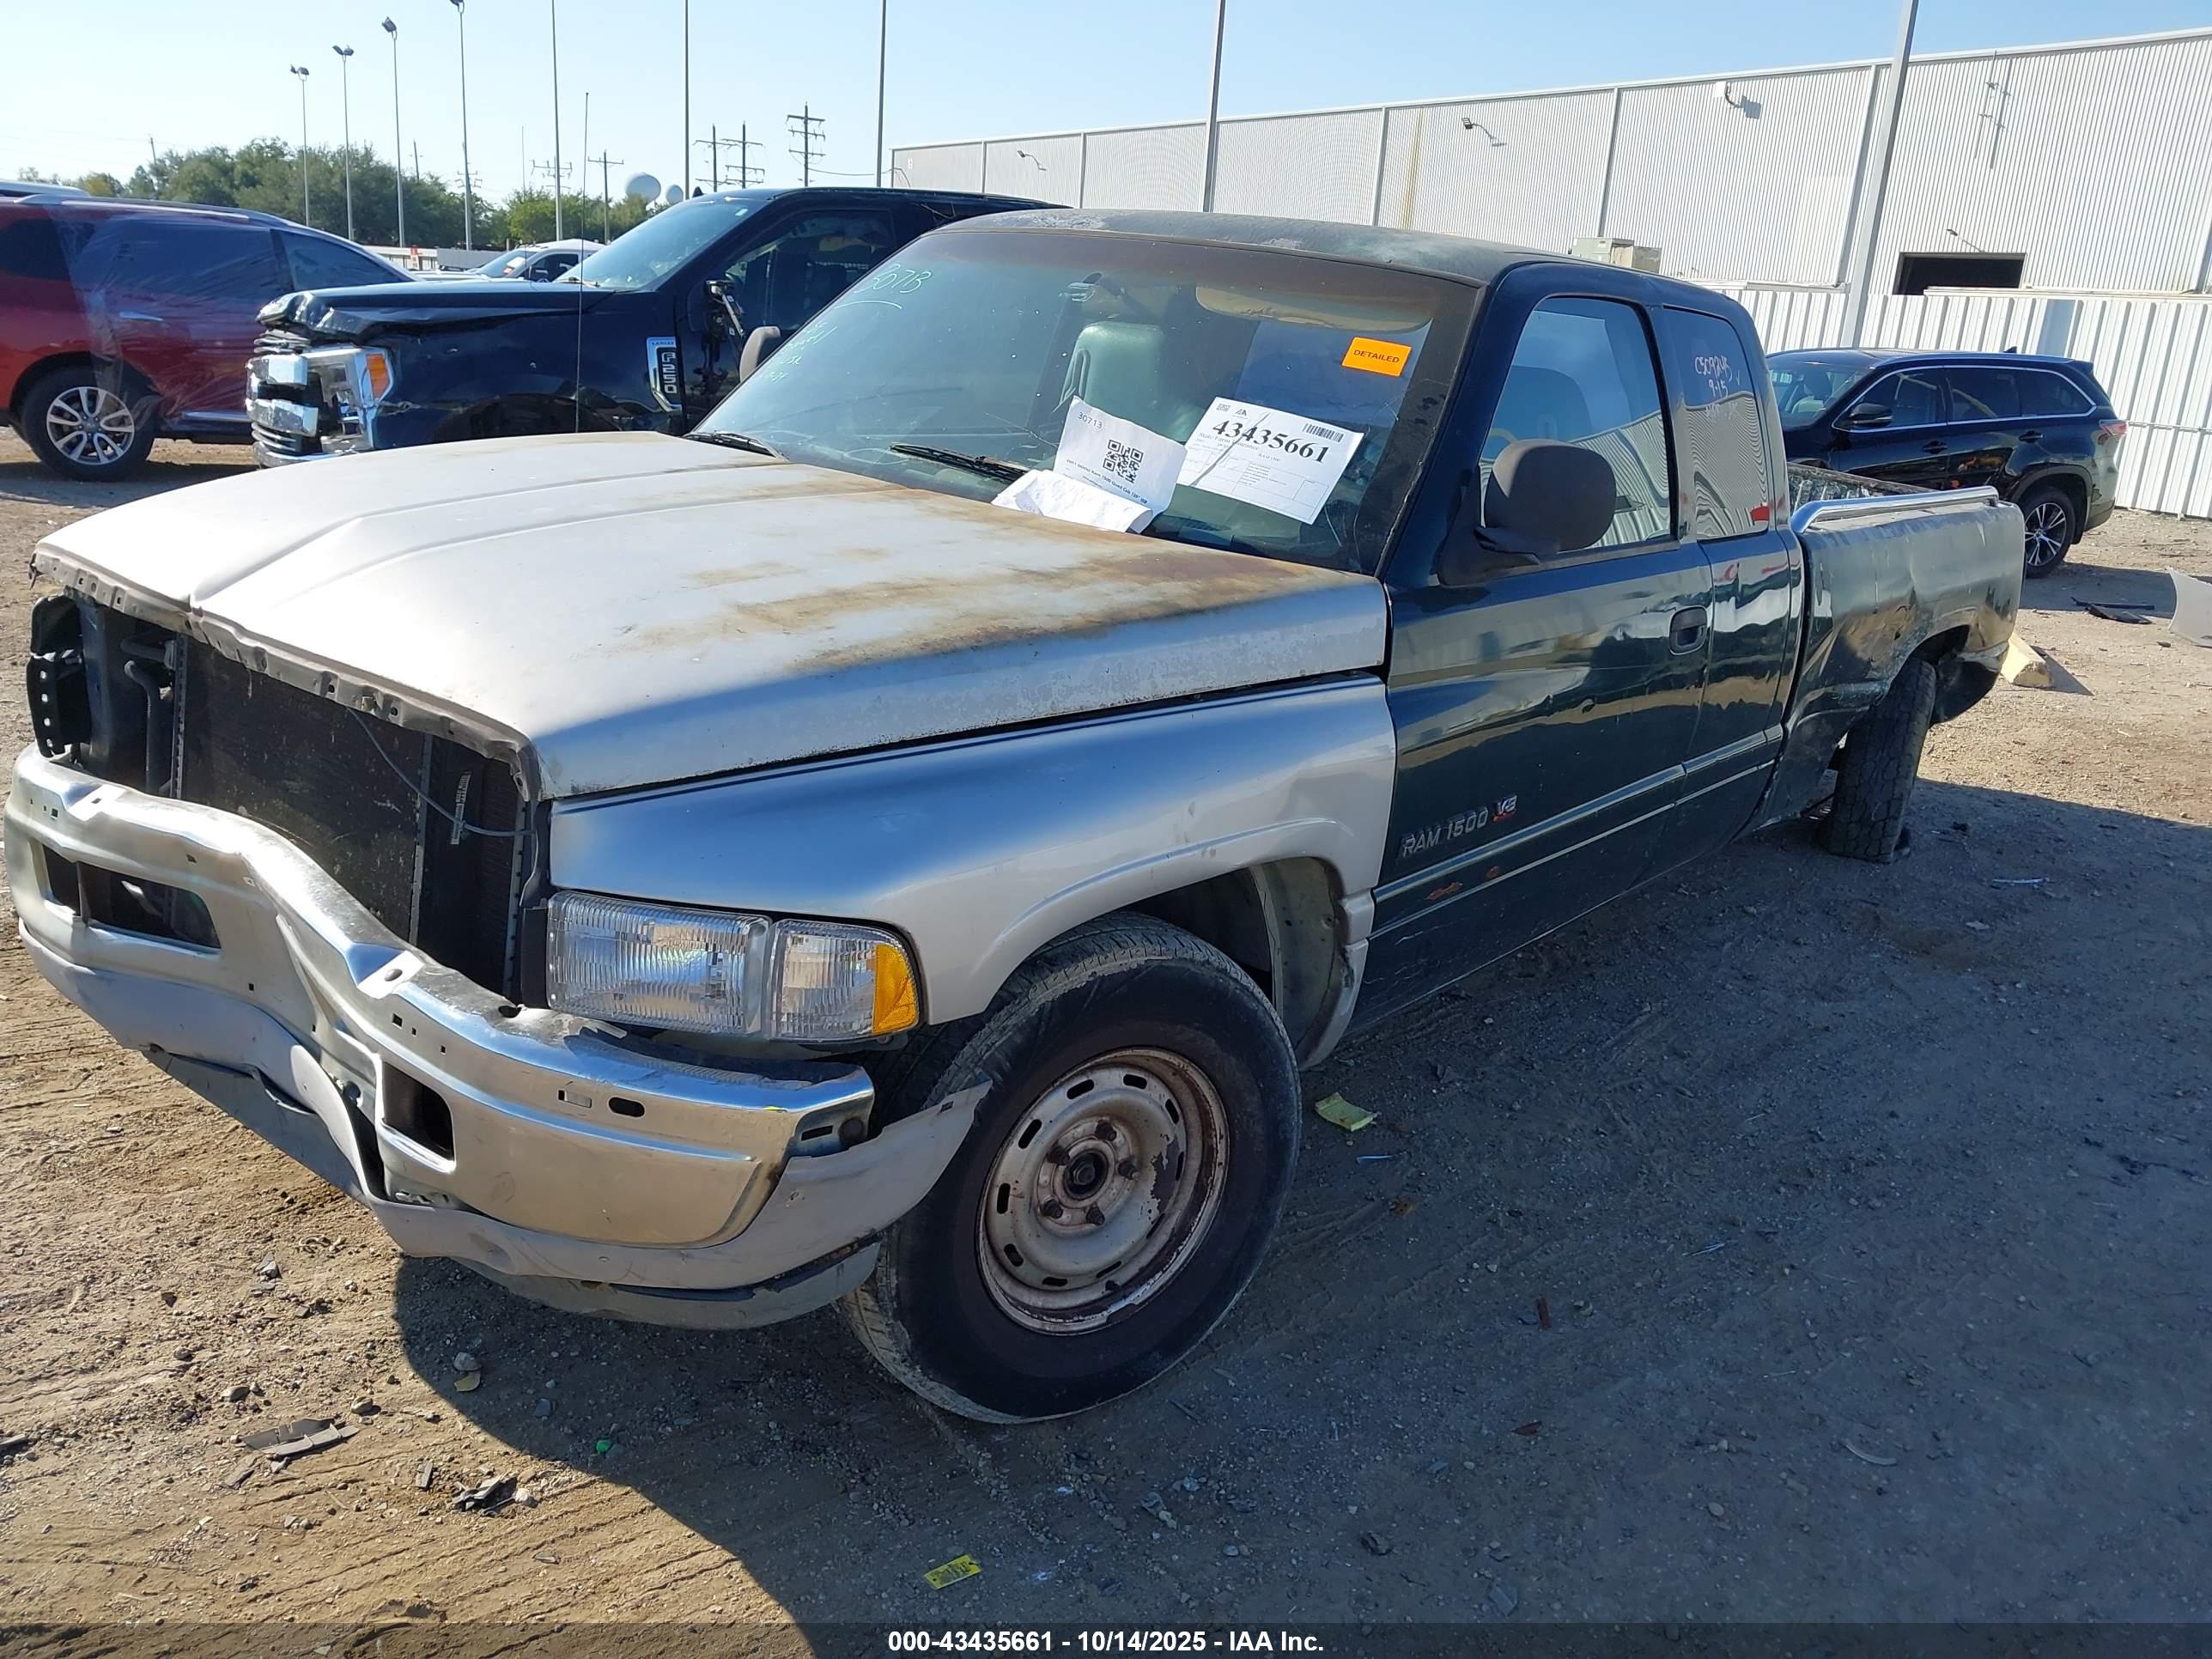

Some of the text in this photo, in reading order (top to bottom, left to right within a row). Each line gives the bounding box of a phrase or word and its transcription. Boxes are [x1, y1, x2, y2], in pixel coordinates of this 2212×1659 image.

[661, 351, 677, 394] F250
[1353, 349, 1401, 363] DETAILED
[1078, 411, 1103, 429] 30713
[1212, 420, 1329, 464] 43435661
[1402, 795, 1517, 857] RAM 1500 V8
